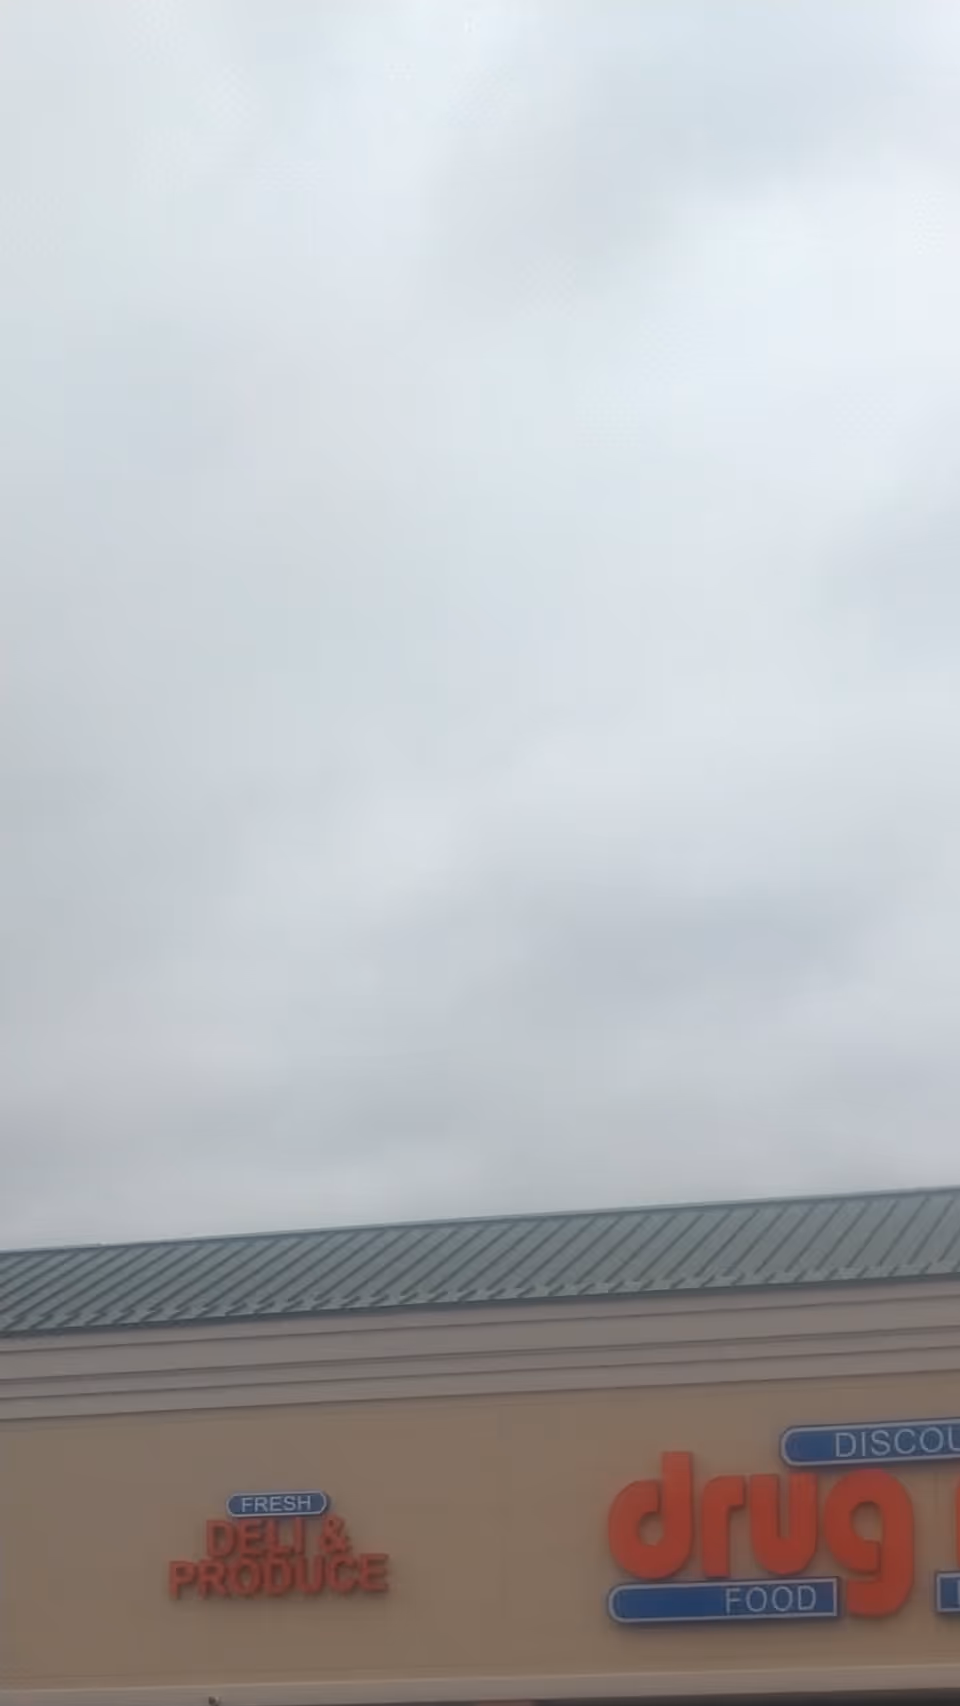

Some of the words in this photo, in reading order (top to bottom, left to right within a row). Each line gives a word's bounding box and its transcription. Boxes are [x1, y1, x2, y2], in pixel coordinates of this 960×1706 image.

[241, 1495, 312, 1513] FRESH
[206, 1516, 306, 1558] DELI
[318, 1514, 353, 1554] &
[608, 1451, 914, 1619] drug
[169, 1553, 390, 1599] PRODUCE
[725, 1584, 817, 1614] FOOD
